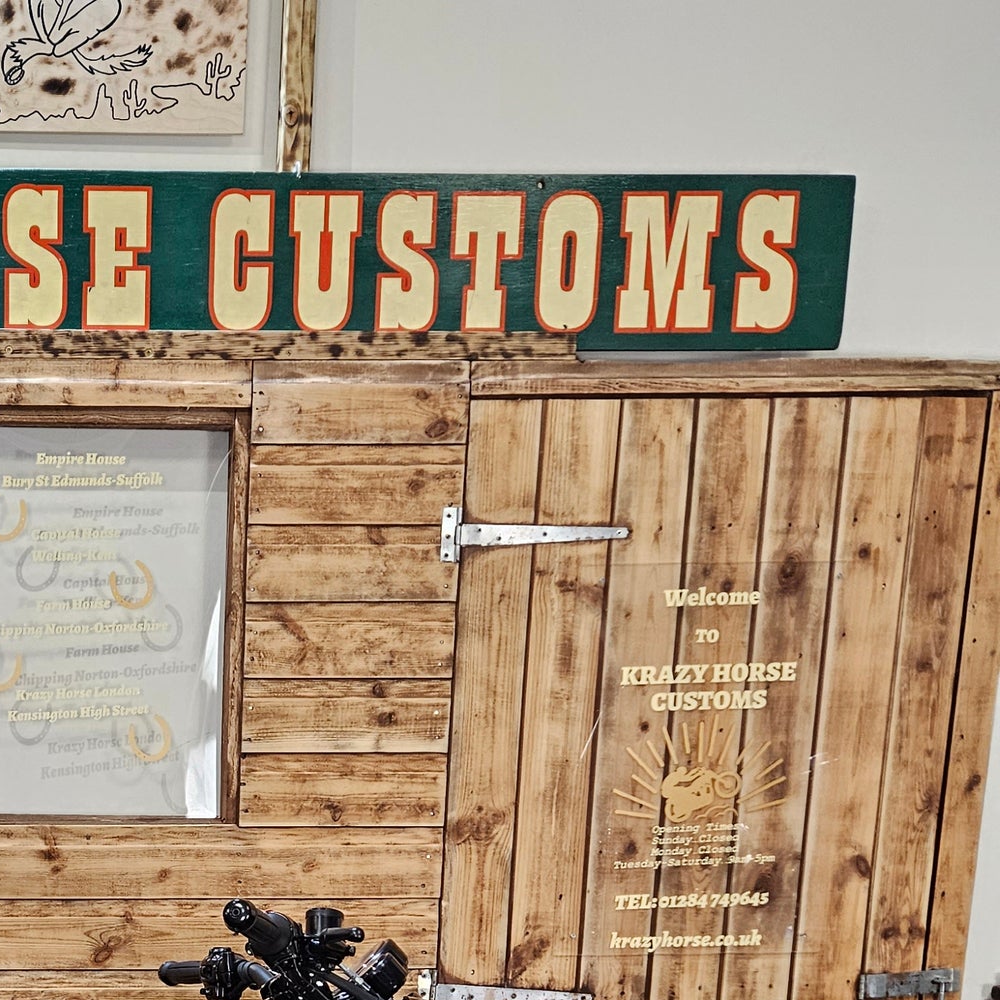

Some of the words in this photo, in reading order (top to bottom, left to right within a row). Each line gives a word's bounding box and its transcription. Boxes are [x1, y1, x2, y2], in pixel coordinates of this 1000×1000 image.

[208, 188, 801, 333] CUSTOMS
[36, 452, 84, 468] Empire
[85, 452, 126, 465] House
[2, 475, 34, 489] Bury
[35, 475, 50, 487] St
[51, 471, 164, 489] Edmunds-Suffolk
[73, 506, 122, 521] Empire
[123, 505, 164, 517] House
[664, 586, 761, 608] Welcome
[695, 628, 720, 643] TO
[65, 645, 100, 659] Farm
[101, 643, 140, 656] House
[74, 660, 198, 682] Norton-Oxfordshire
[620, 663, 711, 687] KRAZY
[711, 661, 798, 684] HORSE
[16, 689, 55, 702] Krazy
[56, 687, 93, 699] Horse
[93, 685, 140, 698] London
[650, 689, 768, 712] CUSTOMS
[7, 709, 79, 724] Kensington
[80, 705, 110, 720] High
[111, 704, 149, 717] Street
[47, 740, 87, 755] Krazy
[40, 760, 111, 780] Kensington
[652, 824, 700, 836] Opening
[709, 891, 769, 907] 749645
[610, 928, 762, 952] krazyhorse.co.uk
